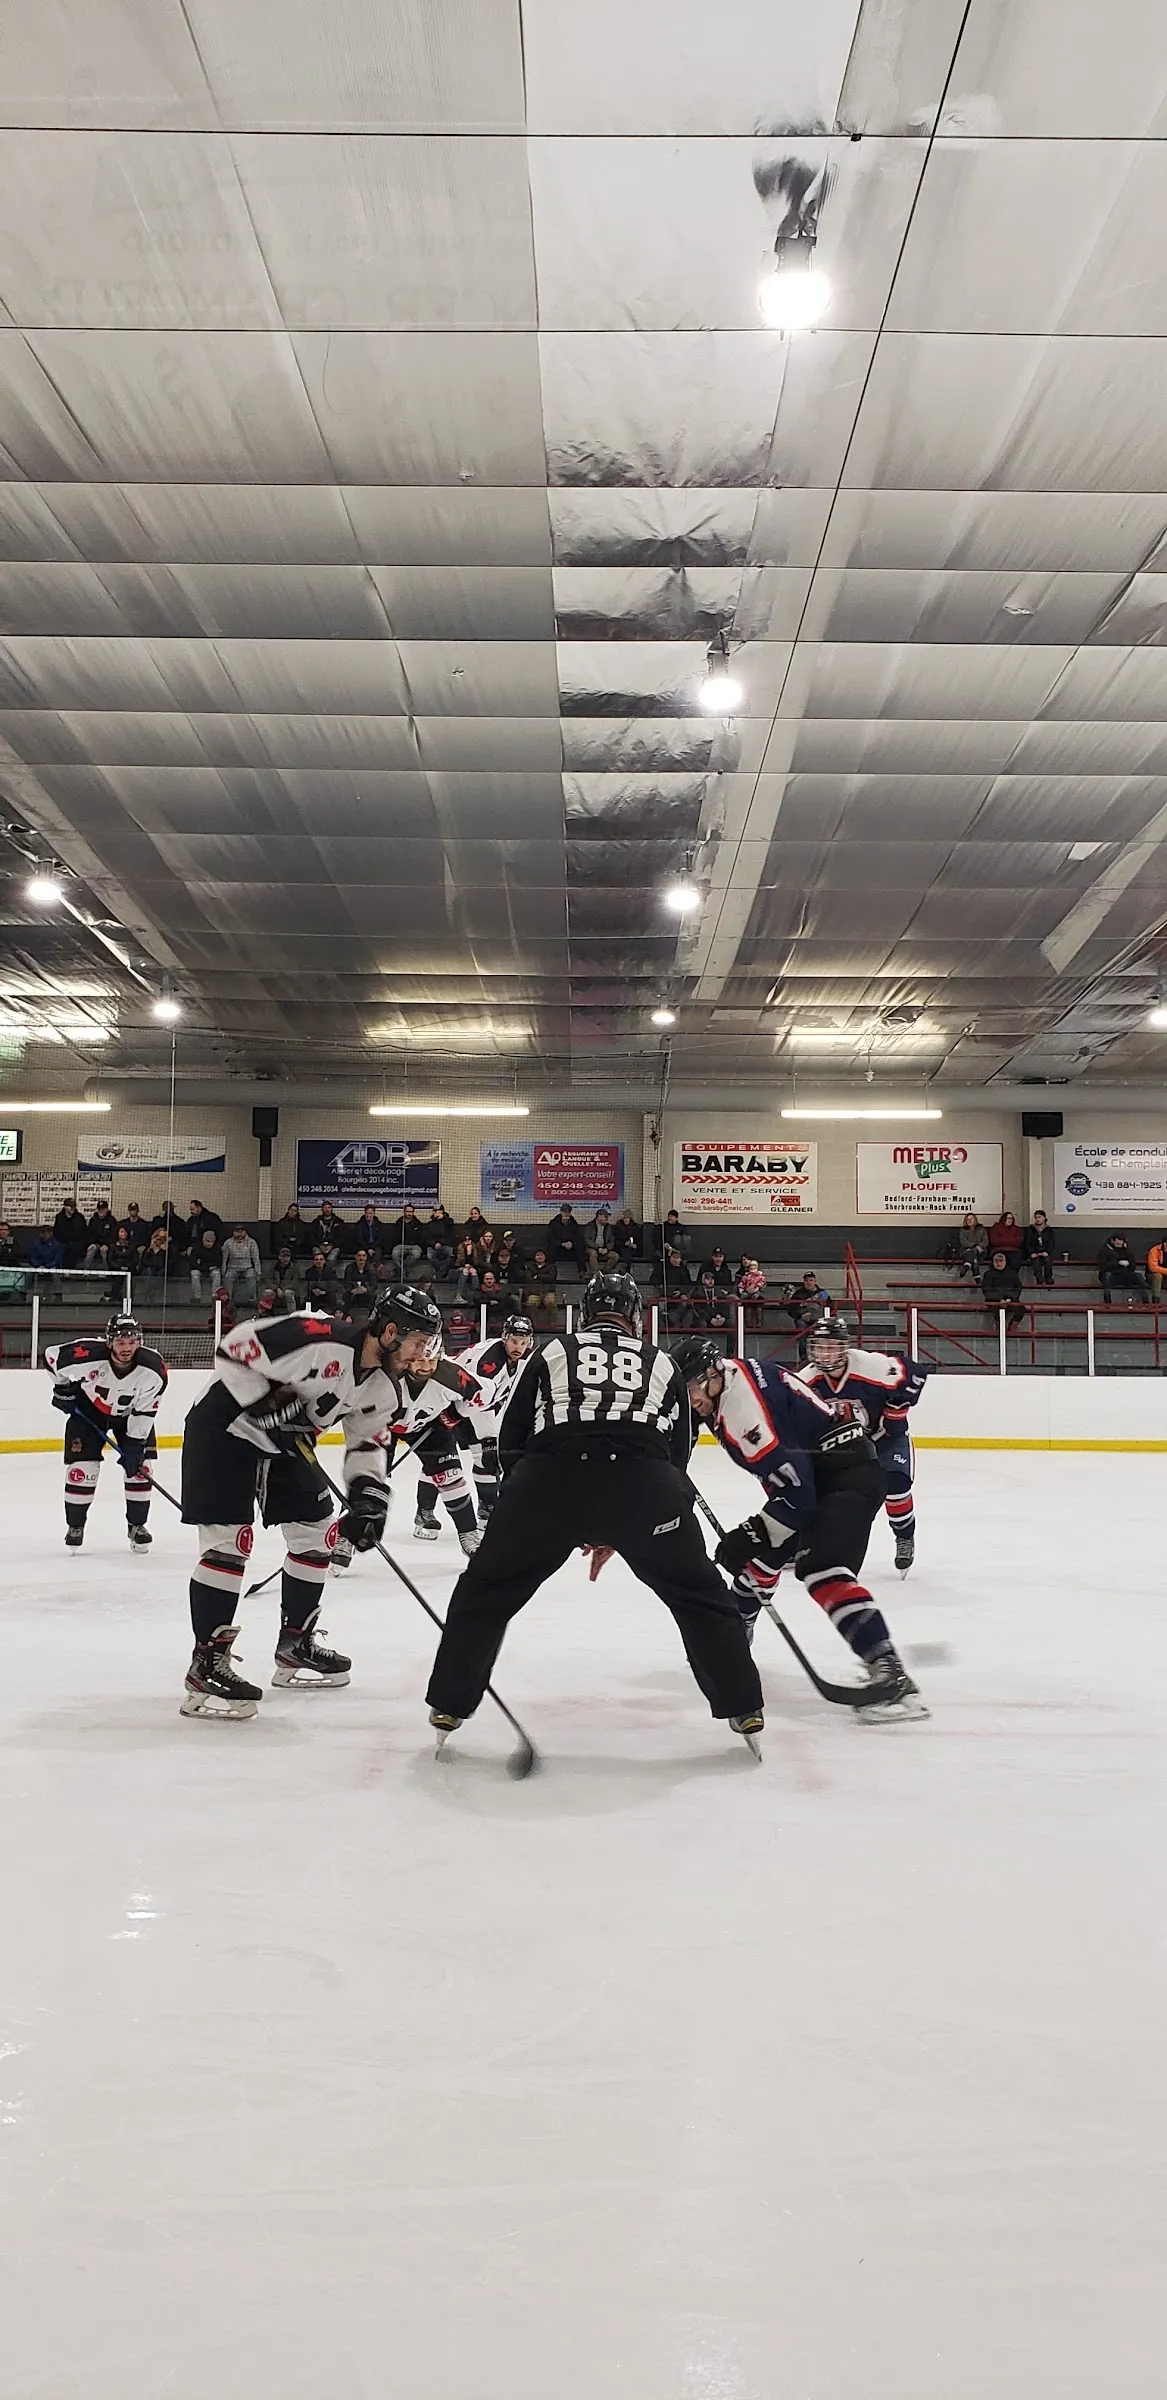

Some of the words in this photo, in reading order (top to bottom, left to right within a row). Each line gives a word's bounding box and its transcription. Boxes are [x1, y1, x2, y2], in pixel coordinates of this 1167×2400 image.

[684, 1143, 808, 1151] ÉQUIPEMENTS
[1075, 1145, 1107, 1156] École
[1111, 1147, 1126, 1156] de
[893, 1147, 968, 1163] METRO
[681, 1155, 810, 1173] BARABY
[1085, 1159, 1107, 1168] Lac
[369, 1176, 385, 1184] 2014
[576, 1345, 643, 1391] 88
[820, 1426, 864, 1452] CCM
[893, 1453, 907, 1464] SW
[446, 1469, 459, 1478] LG
[767, 1462, 802, 1488] 17
[741, 1521, 763, 1543] CM
